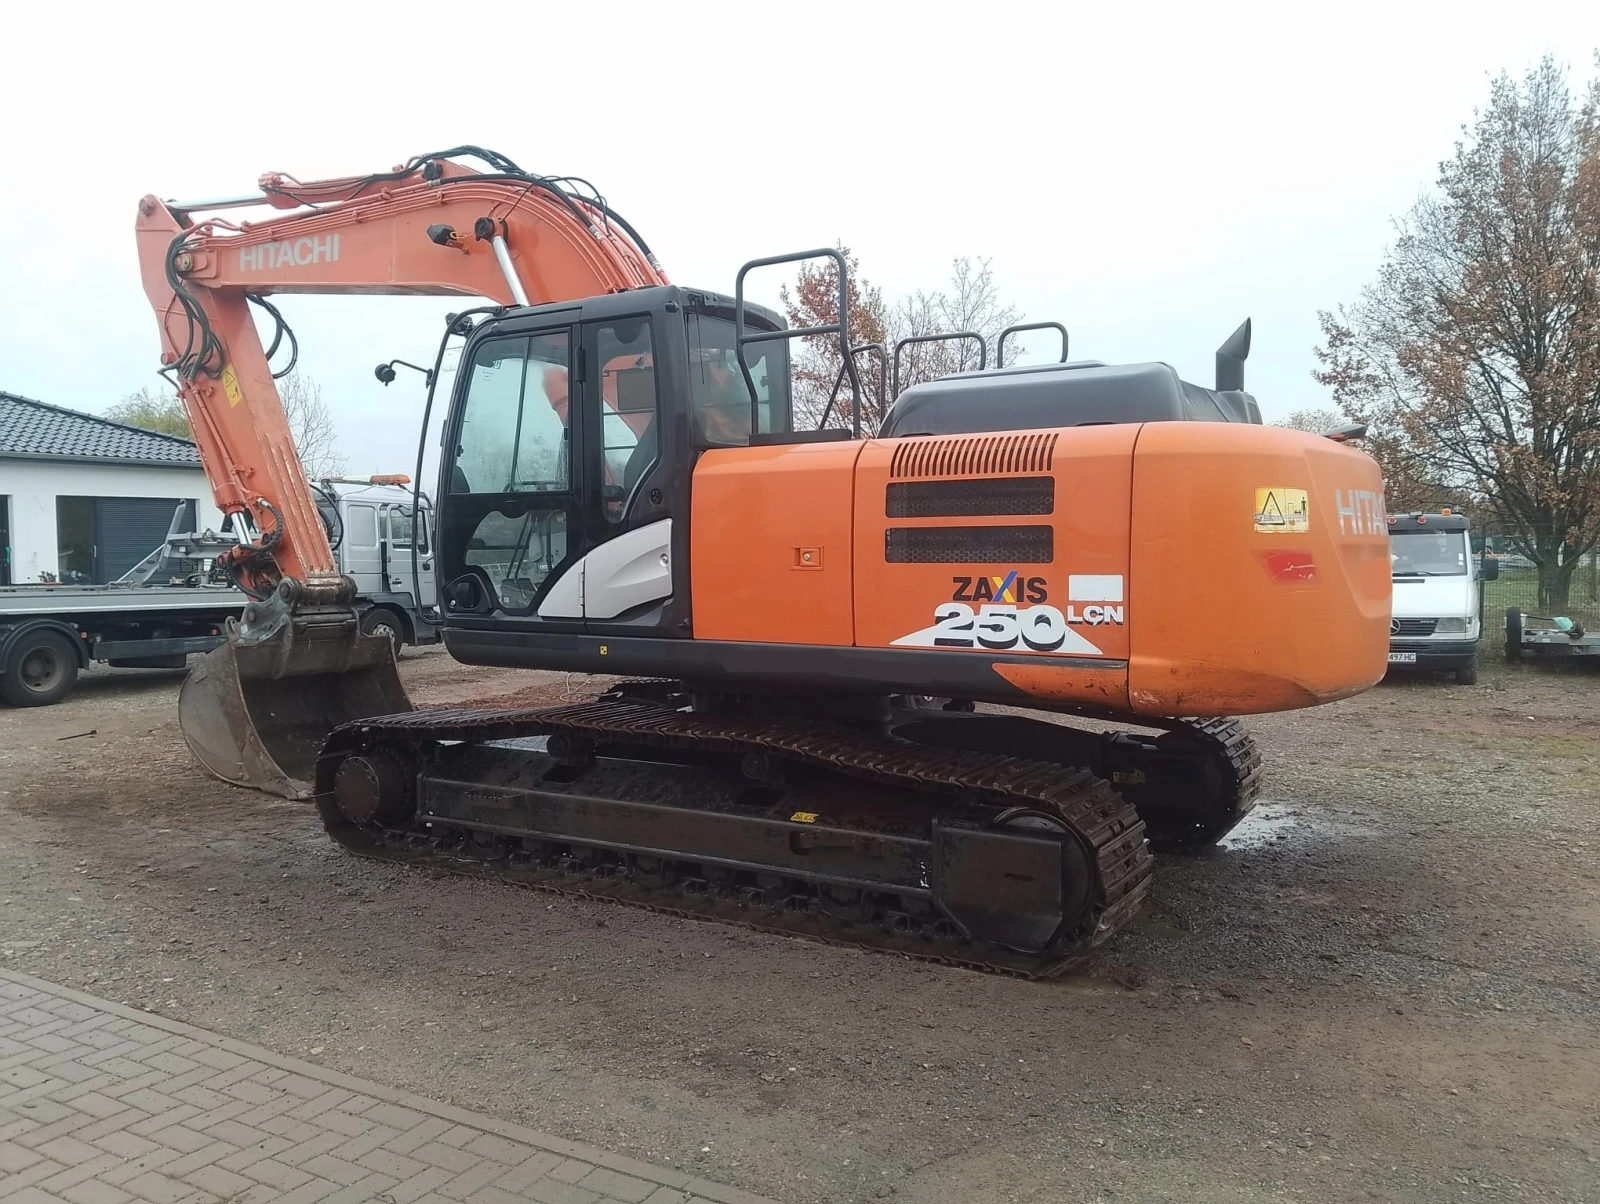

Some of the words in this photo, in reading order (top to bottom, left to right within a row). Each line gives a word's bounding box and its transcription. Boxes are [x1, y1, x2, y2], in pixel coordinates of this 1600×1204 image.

[240, 233, 339, 271] HITACHI
[952, 570, 1048, 603] ZAXIS
[934, 602, 1065, 651] 250
[1067, 605, 1124, 626] LCN
